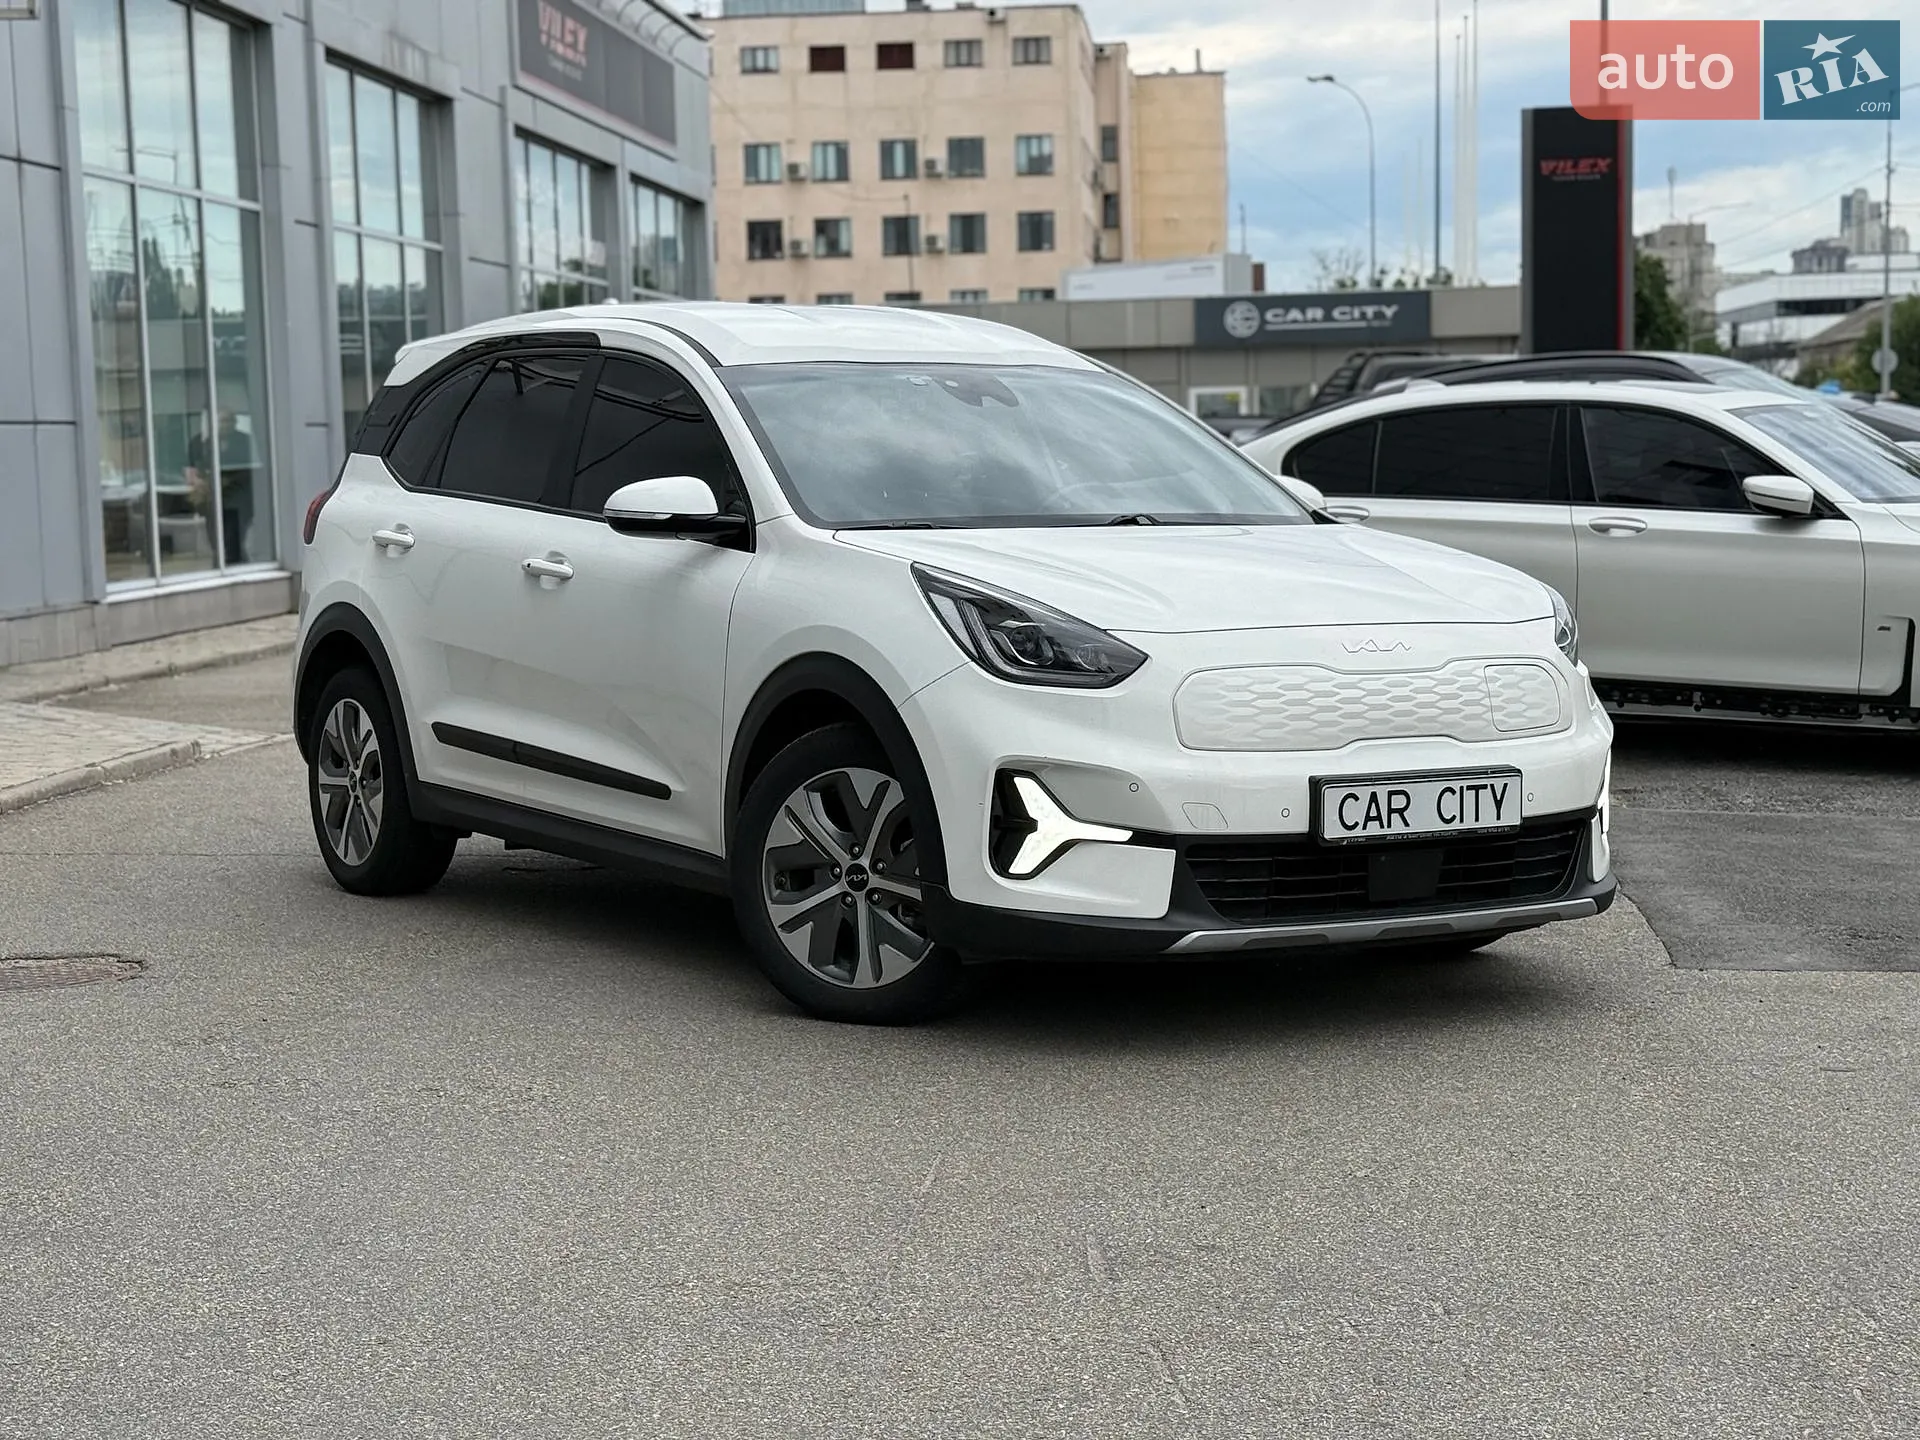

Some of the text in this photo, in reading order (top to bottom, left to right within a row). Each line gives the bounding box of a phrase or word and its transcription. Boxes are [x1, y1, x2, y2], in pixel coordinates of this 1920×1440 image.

[1540, 157, 1612, 175] VILEX
[1264, 304, 1399, 323] CAR CITY
[1337, 782, 1509, 832] CAR CITY
